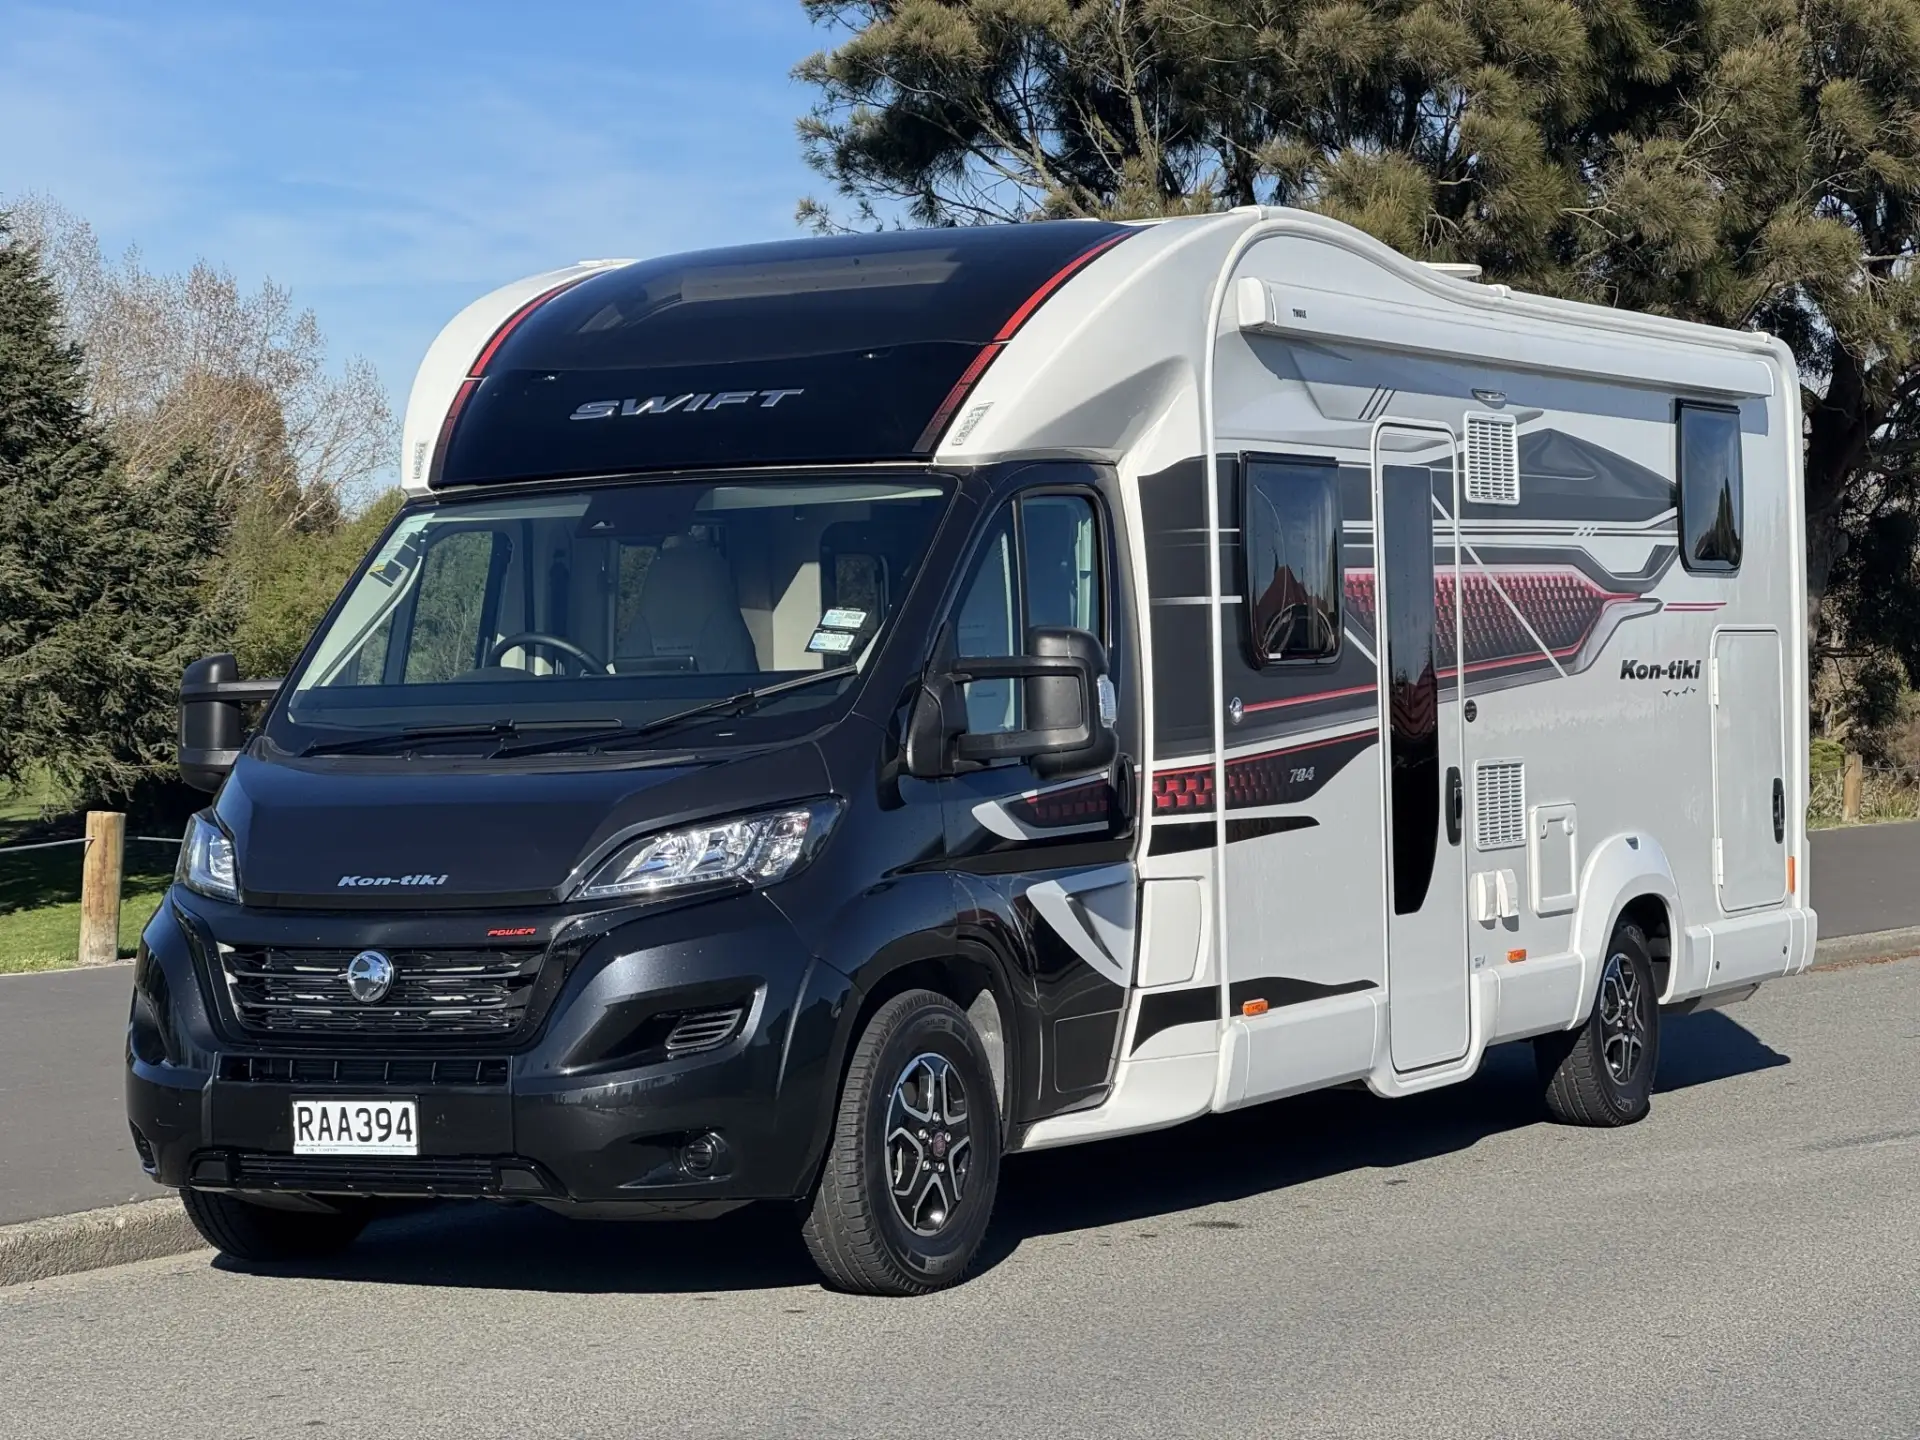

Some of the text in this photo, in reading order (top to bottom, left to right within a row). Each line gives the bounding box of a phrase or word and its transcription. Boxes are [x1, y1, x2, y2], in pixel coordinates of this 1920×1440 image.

[569, 388, 805, 420] SWIFT
[1620, 659, 1702, 680] Kon-tiki
[1289, 766, 1315, 784] 784
[337, 874, 449, 887] Kon-tiki
[487, 927, 537, 937] POWER
[297, 1106, 413, 1143] RAA394
